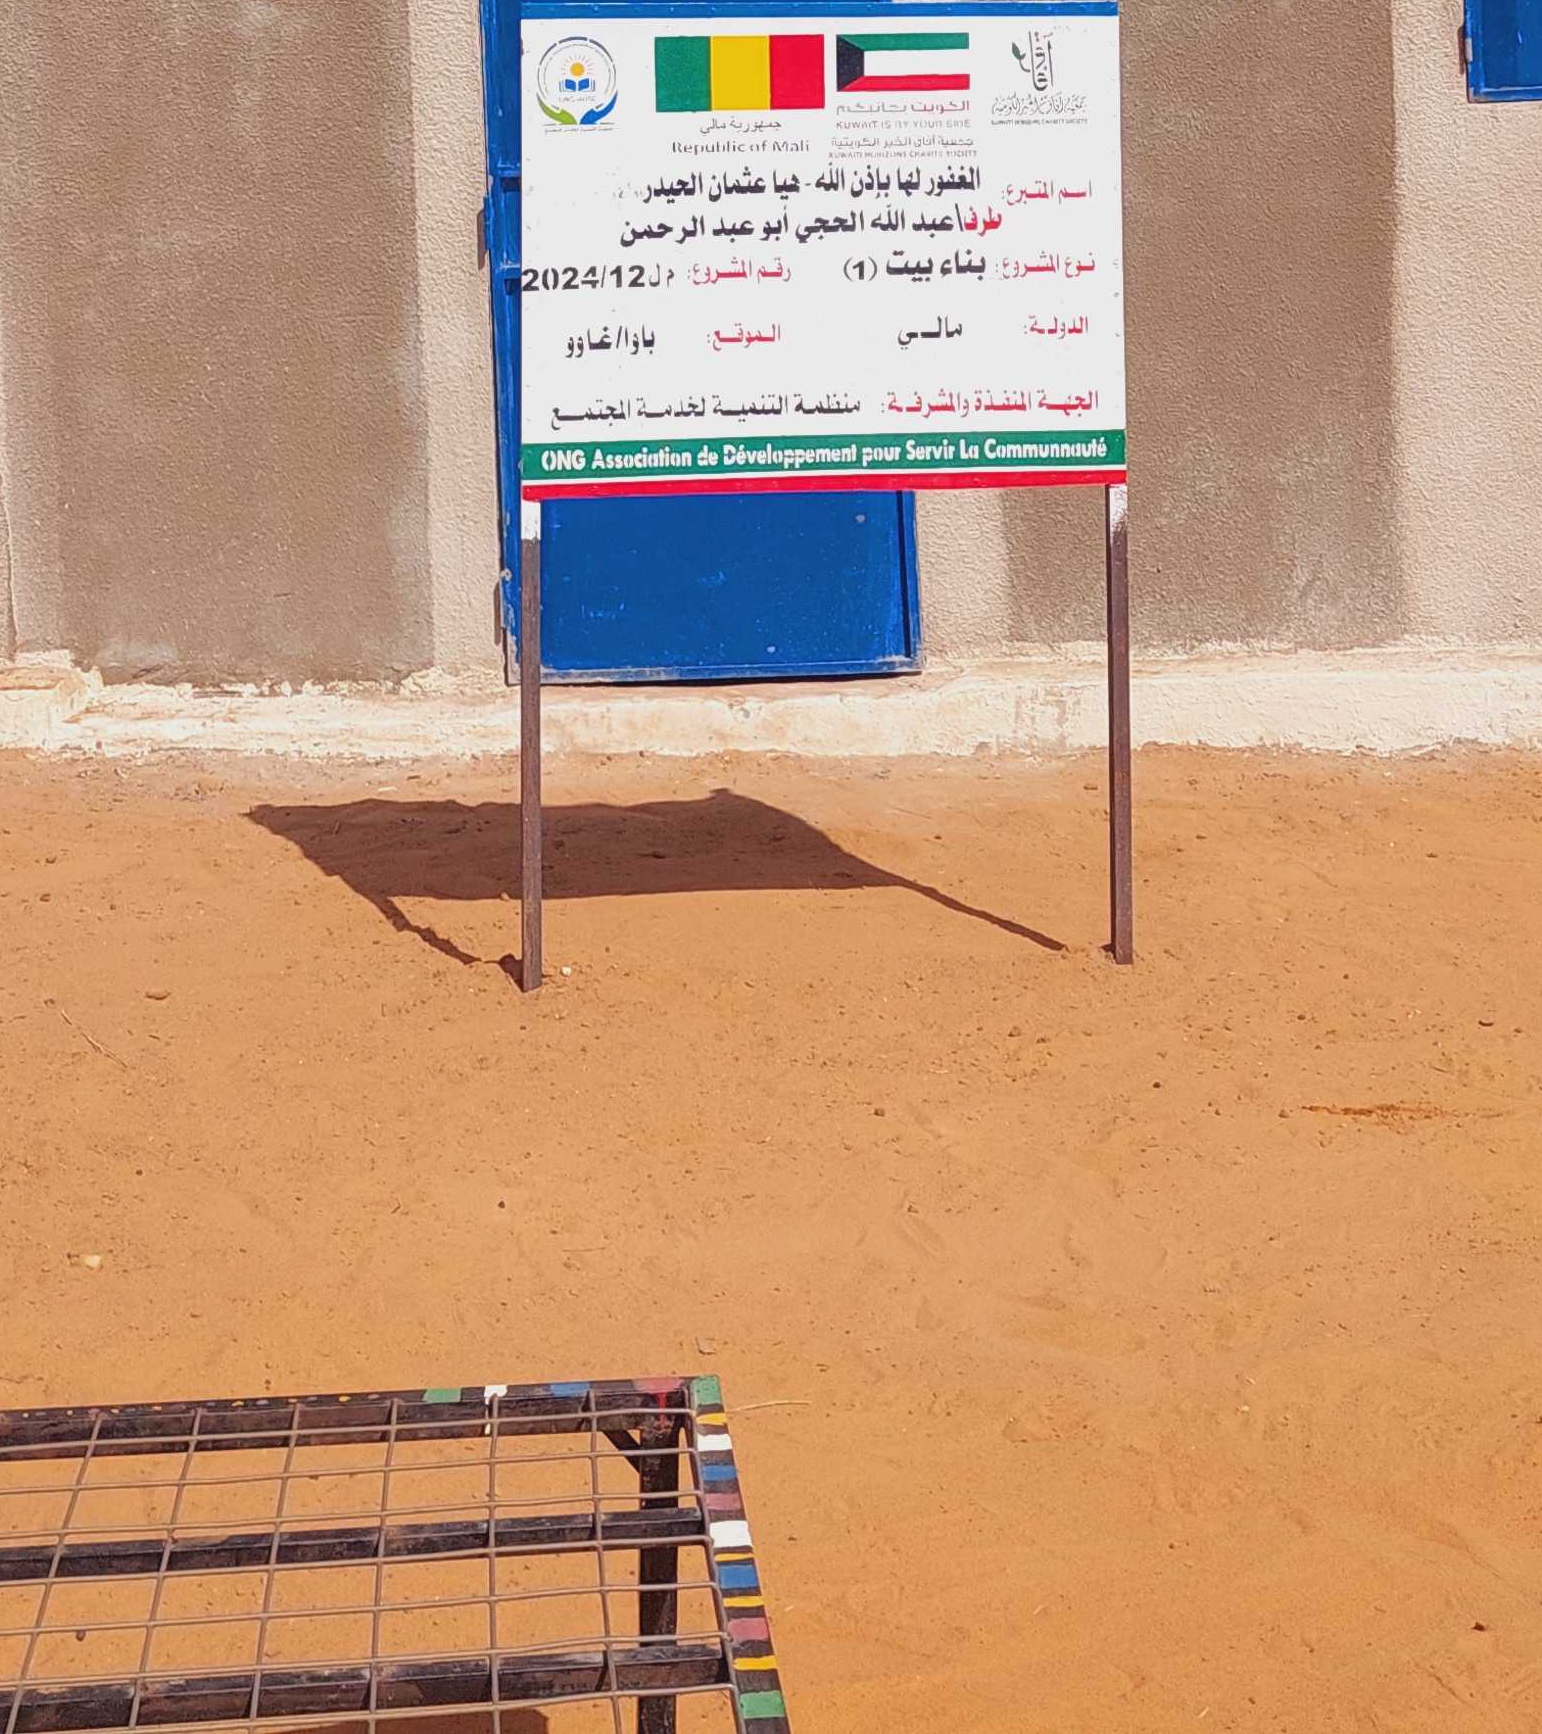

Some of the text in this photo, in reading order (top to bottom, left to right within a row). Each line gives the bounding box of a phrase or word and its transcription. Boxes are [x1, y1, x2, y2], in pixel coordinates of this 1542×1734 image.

[700, 116, 781, 136] جمهورية مالي
[836, 121, 878, 129] KUWAIT
[882, 121, 891, 129] IS
[673, 140, 809, 155] Republic of Mali
[643, 173, 703, 204] الحيدر
[709, 166, 766, 202] عثمان
[773, 171, 800, 200] هيا
[815, 162, 845, 191] الله
[851, 165, 890, 198] بإذن
[897, 167, 920, 197] لها
[1001, 181, 1053, 206] المتبرع:
[1059, 183, 1091, 203] اسم
[620, 215, 705, 247] الرحمن
[713, 218, 754, 243] عبد
[760, 206, 788, 241] أبو
[795, 209, 865, 244] الحجي
[871, 205, 905, 231] الله
[757, 258, 791, 282] رقم
[843, 257, 877, 281] (1)
[886, 250, 933, 282] بيت
[940, 249, 986, 281] بناء
[1065, 253, 1095, 278] نوع
[707, 323, 780, 351] الموقع:
[1024, 316, 1088, 339] الدولة:
[637, 396, 705, 418] لخدمة
[712, 394, 788, 422] التنمية
[794, 394, 860, 414] منظمة
[975, 390, 1031, 411] المنفذة
[1037, 390, 1098, 416] الجهة
[551, 400, 630, 430] المجتمع
[542, 438, 1107, 470] ONG Association de Développement pour Servir La Communnauté
